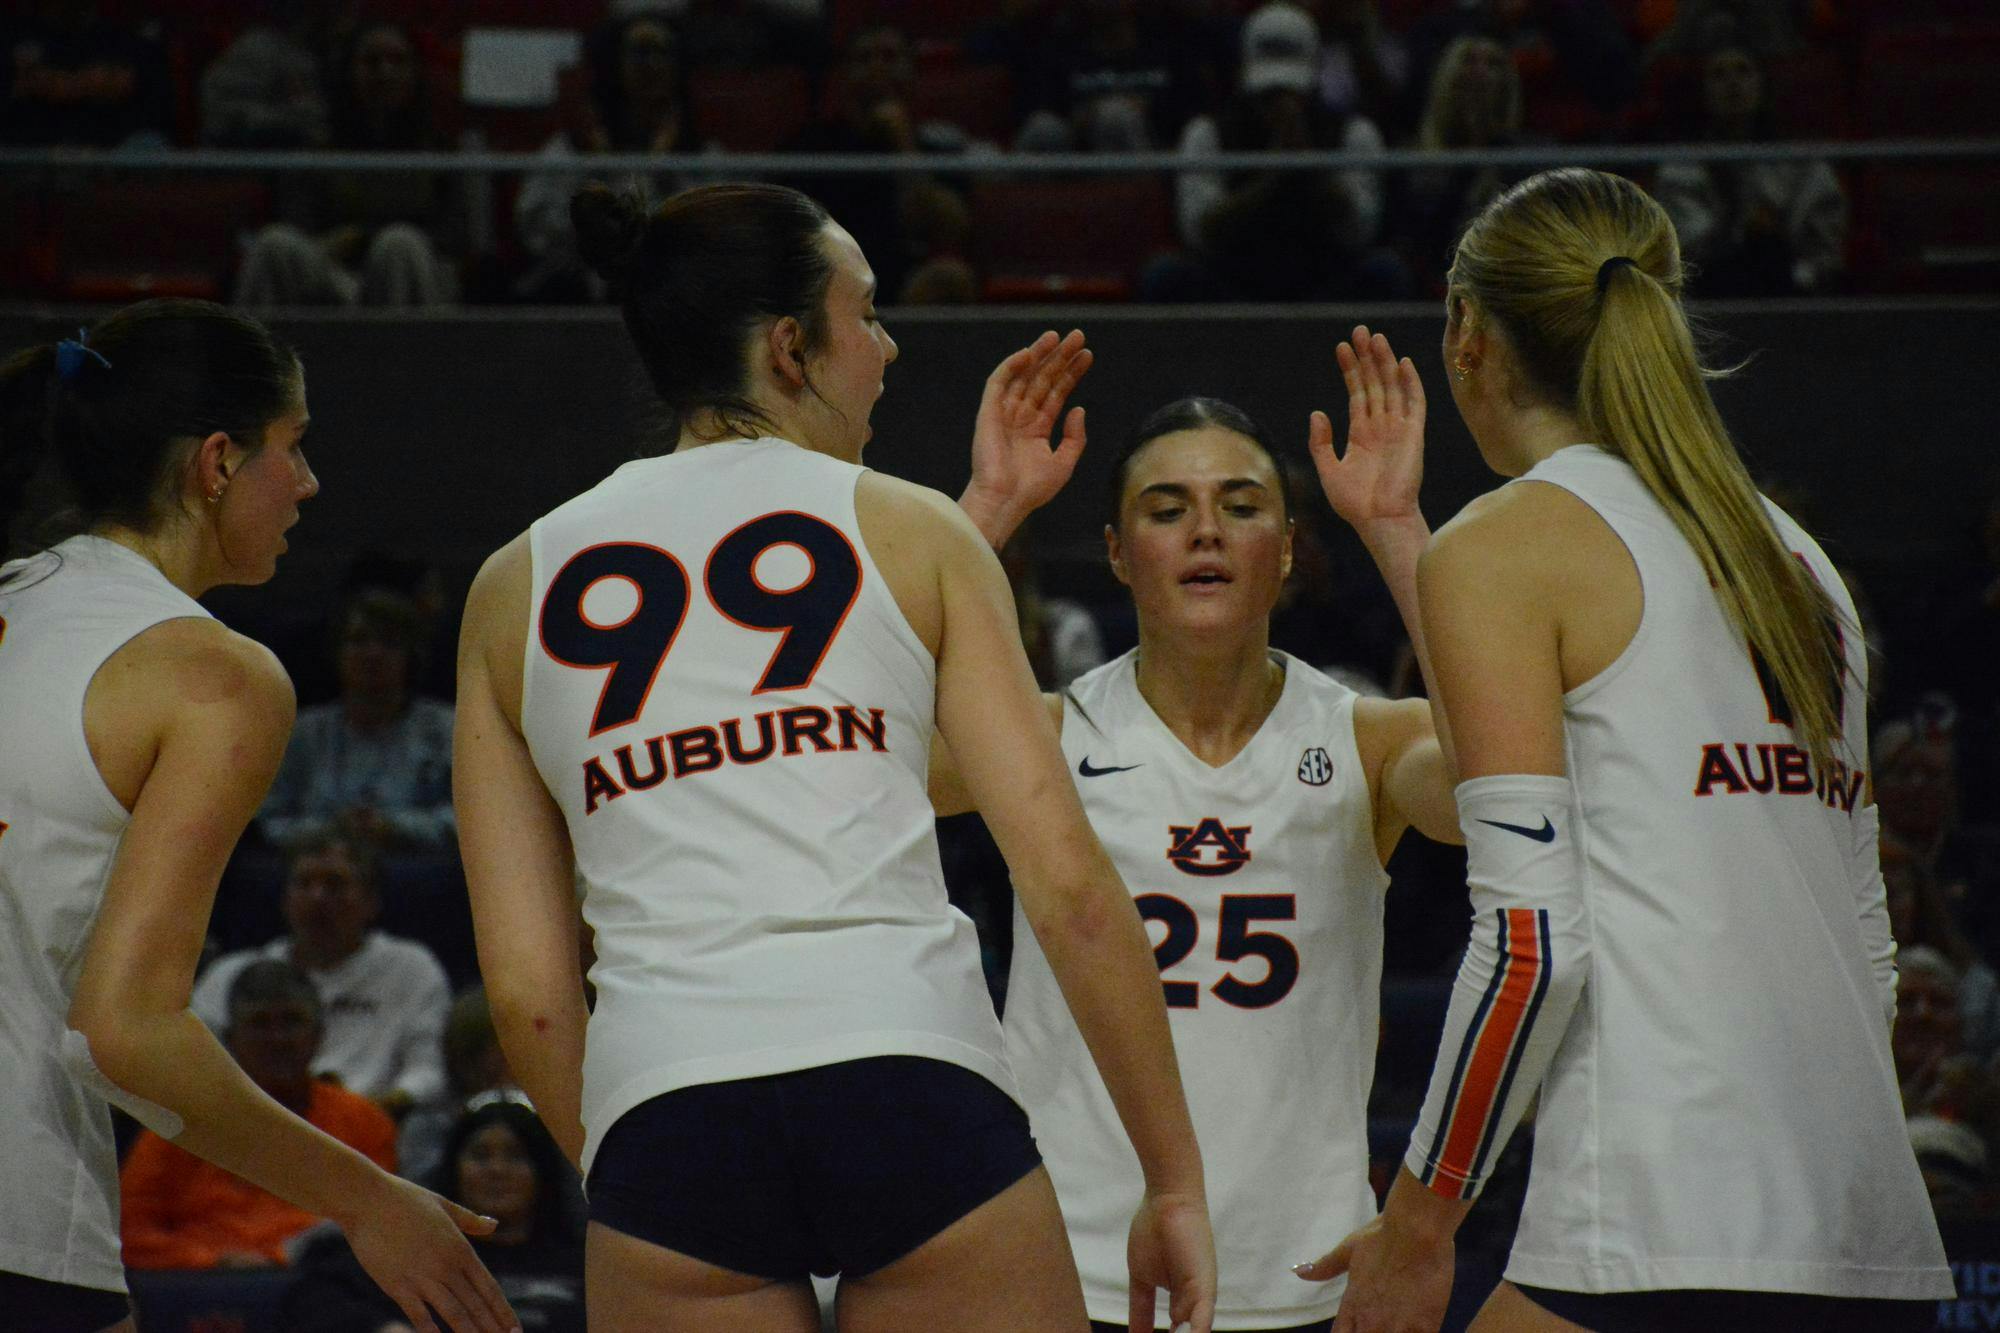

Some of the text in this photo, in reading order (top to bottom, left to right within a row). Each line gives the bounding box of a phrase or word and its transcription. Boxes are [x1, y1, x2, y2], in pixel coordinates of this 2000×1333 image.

[539, 510, 863, 738] 99
[582, 705, 889, 816] AUBURN
[1298, 747, 1333, 786] SEC
[1133, 893, 1299, 1009] 25
